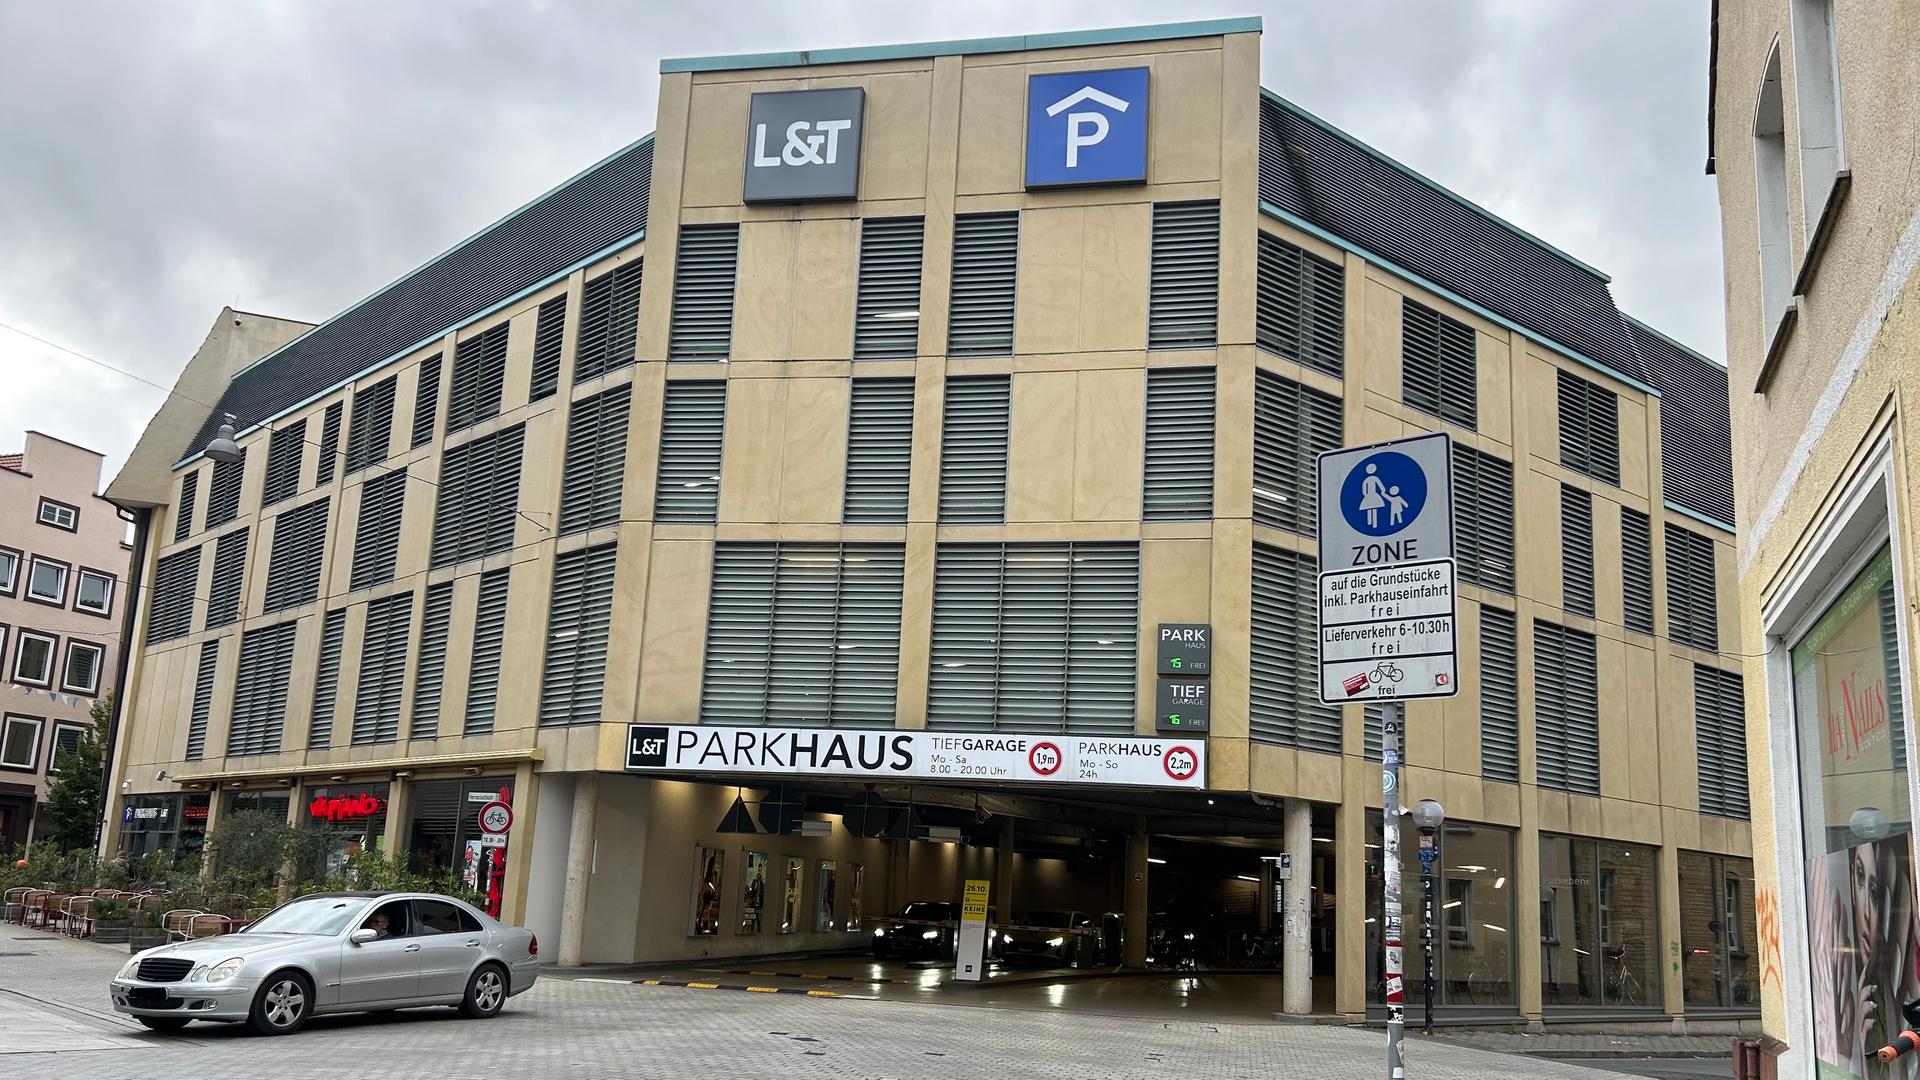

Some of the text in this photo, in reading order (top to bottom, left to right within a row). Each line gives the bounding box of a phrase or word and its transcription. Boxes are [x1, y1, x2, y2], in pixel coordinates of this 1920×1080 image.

[753, 119, 852, 168] L&T
[1065, 111, 1110, 168] P
[1351, 538, 1419, 567] ZONE
[1331, 568, 1441, 592] auf die Grundstücke
[1324, 584, 1449, 608] inkl. Parkhauseinfahrt
[1161, 629, 1206, 642] PARK
[1325, 623, 1397, 643] Lieferverkehr
[1170, 684, 1205, 698] TIEF
[1377, 685, 1396, 695] frei
[1171, 698, 1205, 706] GARAGE
[632, 738, 666, 755] L&T
[675, 730, 914, 771] PARKHAUS
[931, 737, 1027, 752] TIEFGARAGE
[1078, 742, 1162, 757] PARKHAUS
[931, 754, 946, 764] Mo
[955, 755, 967, 764] Sa
[1036, 752, 1055, 765] 1,9m
[1079, 759, 1096, 768] Mo
[1105, 760, 1118, 769] So
[1170, 756, 1192, 770] 2,2m
[929, 764, 951, 774] 8.00
[960, 765, 987, 775] 20.00
[989, 766, 1007, 776] Uhr
[1079, 769, 1098, 779] 24h
[964, 905, 986, 913] KEINE
